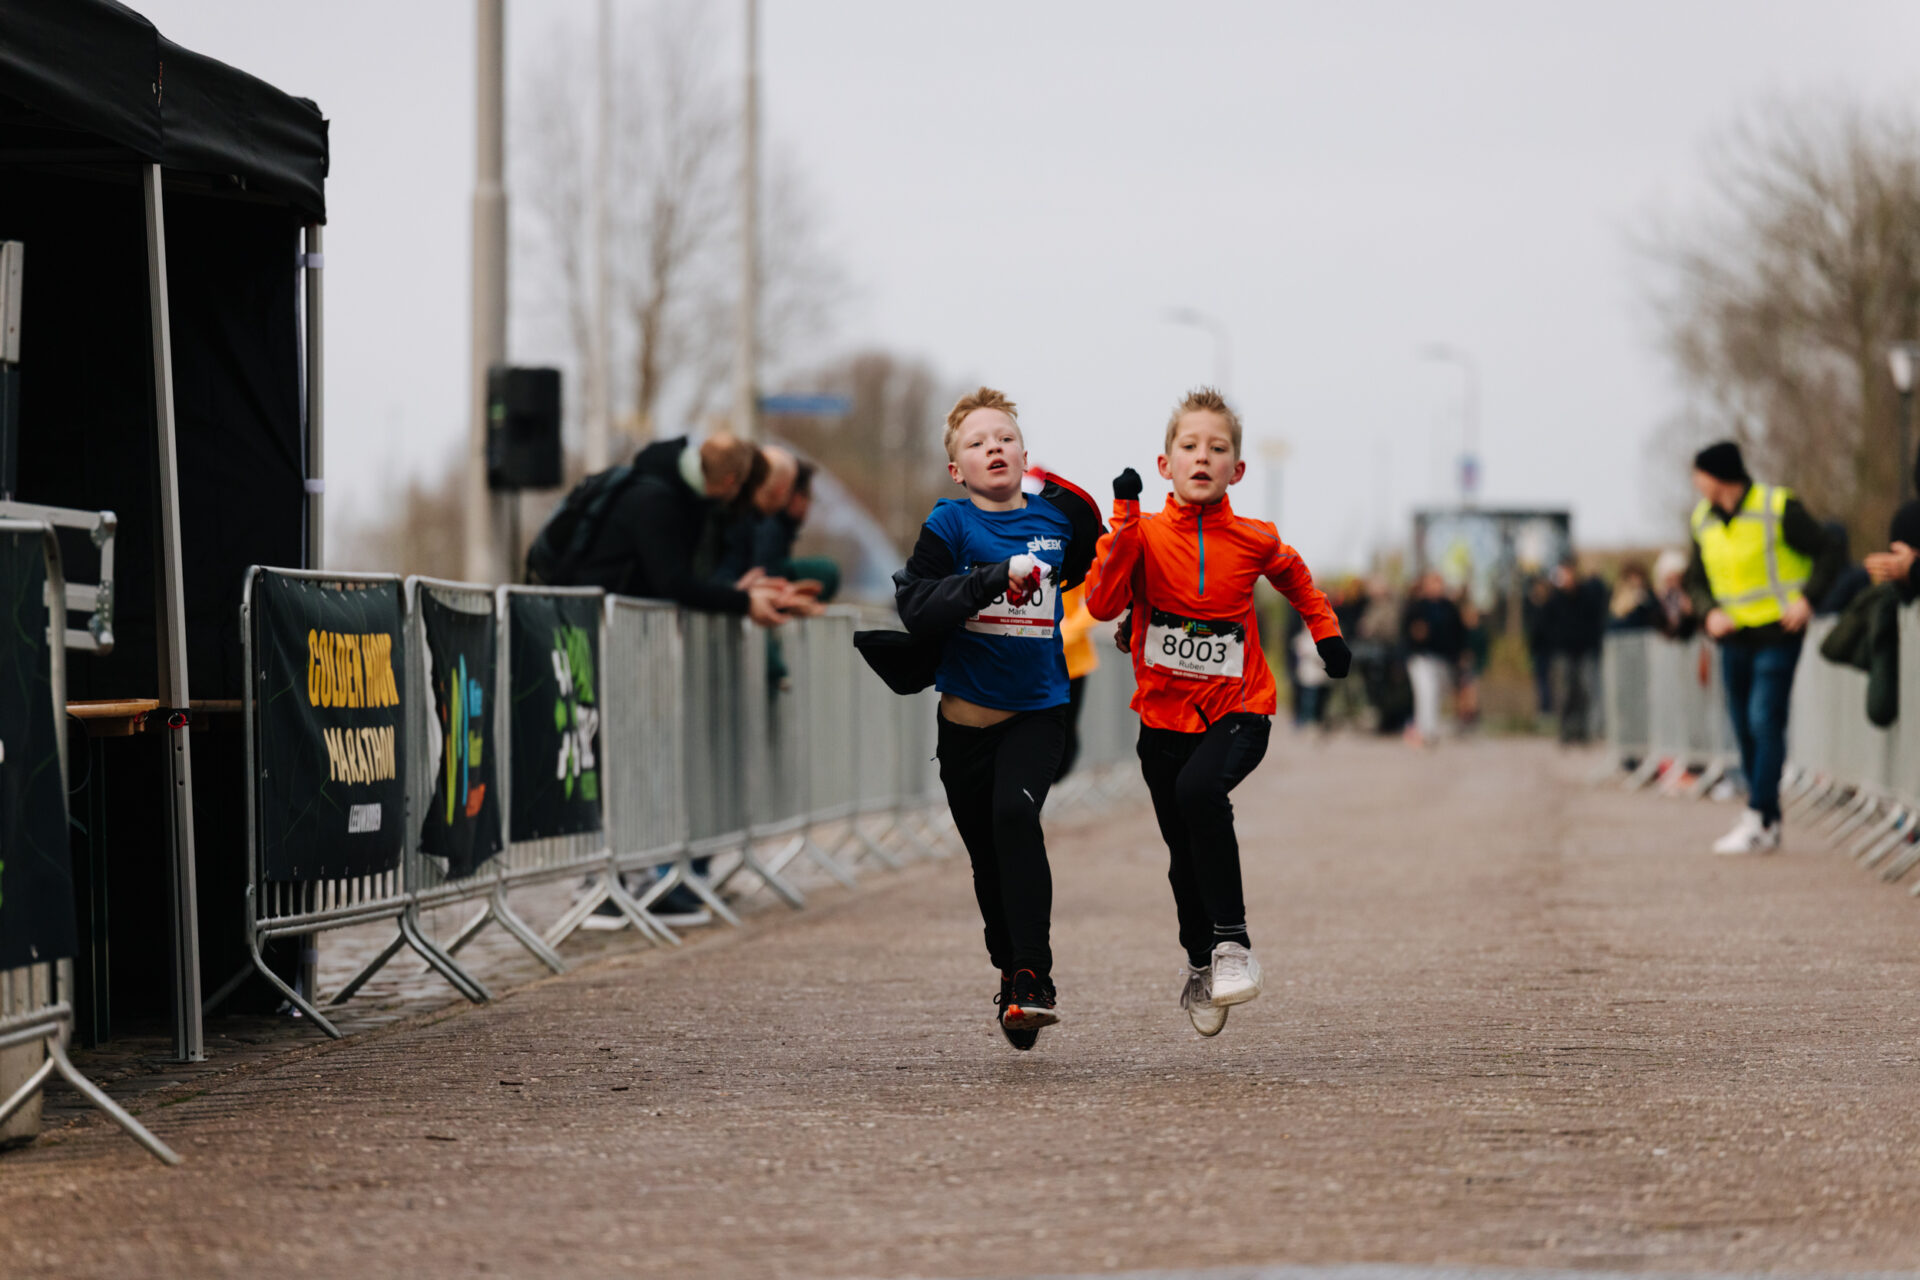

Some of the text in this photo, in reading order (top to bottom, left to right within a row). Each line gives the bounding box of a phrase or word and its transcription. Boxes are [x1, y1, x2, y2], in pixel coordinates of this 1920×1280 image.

[1008, 608, 1027, 616] Mark
[1162, 634, 1227, 663] 8003
[308, 628, 400, 708] GOLDEN HOUR
[1178, 659, 1206, 672] Ruben
[323, 725, 396, 786] MARATHON
